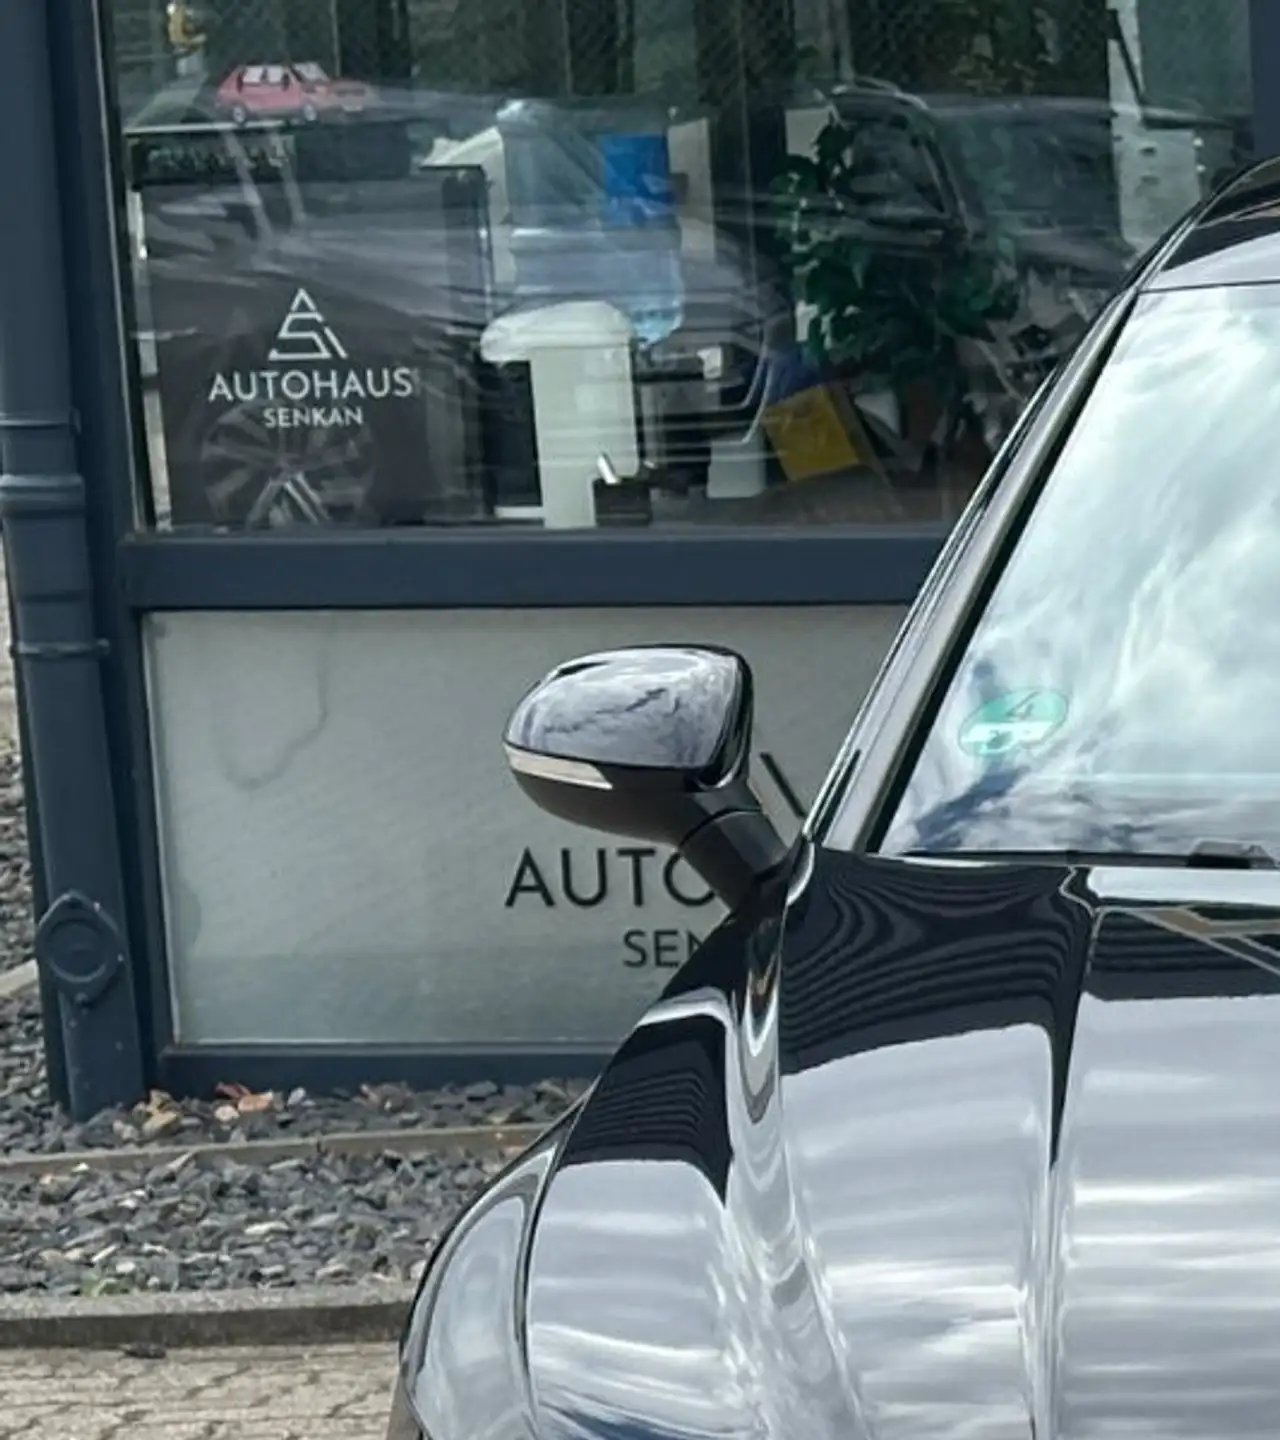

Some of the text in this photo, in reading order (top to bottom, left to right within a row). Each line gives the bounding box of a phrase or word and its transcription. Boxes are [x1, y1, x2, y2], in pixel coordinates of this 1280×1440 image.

[208, 367, 413, 402] AUTOHAUS
[263, 407, 364, 428] SENKAN
[504, 846, 716, 908] AUTO
